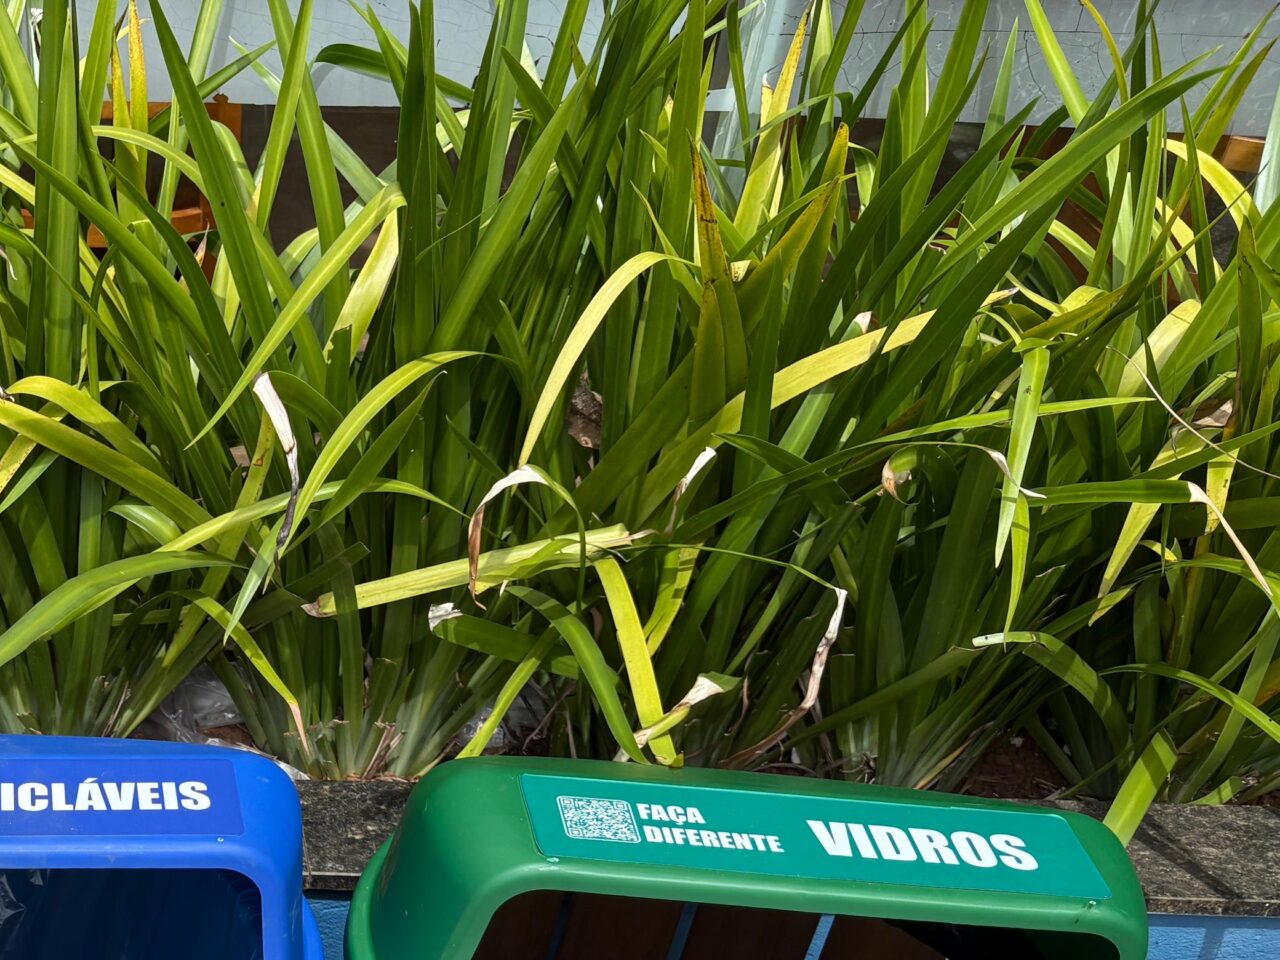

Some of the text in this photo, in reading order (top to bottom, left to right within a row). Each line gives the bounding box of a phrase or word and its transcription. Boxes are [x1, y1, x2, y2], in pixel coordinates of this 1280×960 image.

[637, 803, 705, 825] FAÇA
[643, 826, 784, 853] DIFERENTE
[807, 820, 1039, 871] VIDROS
